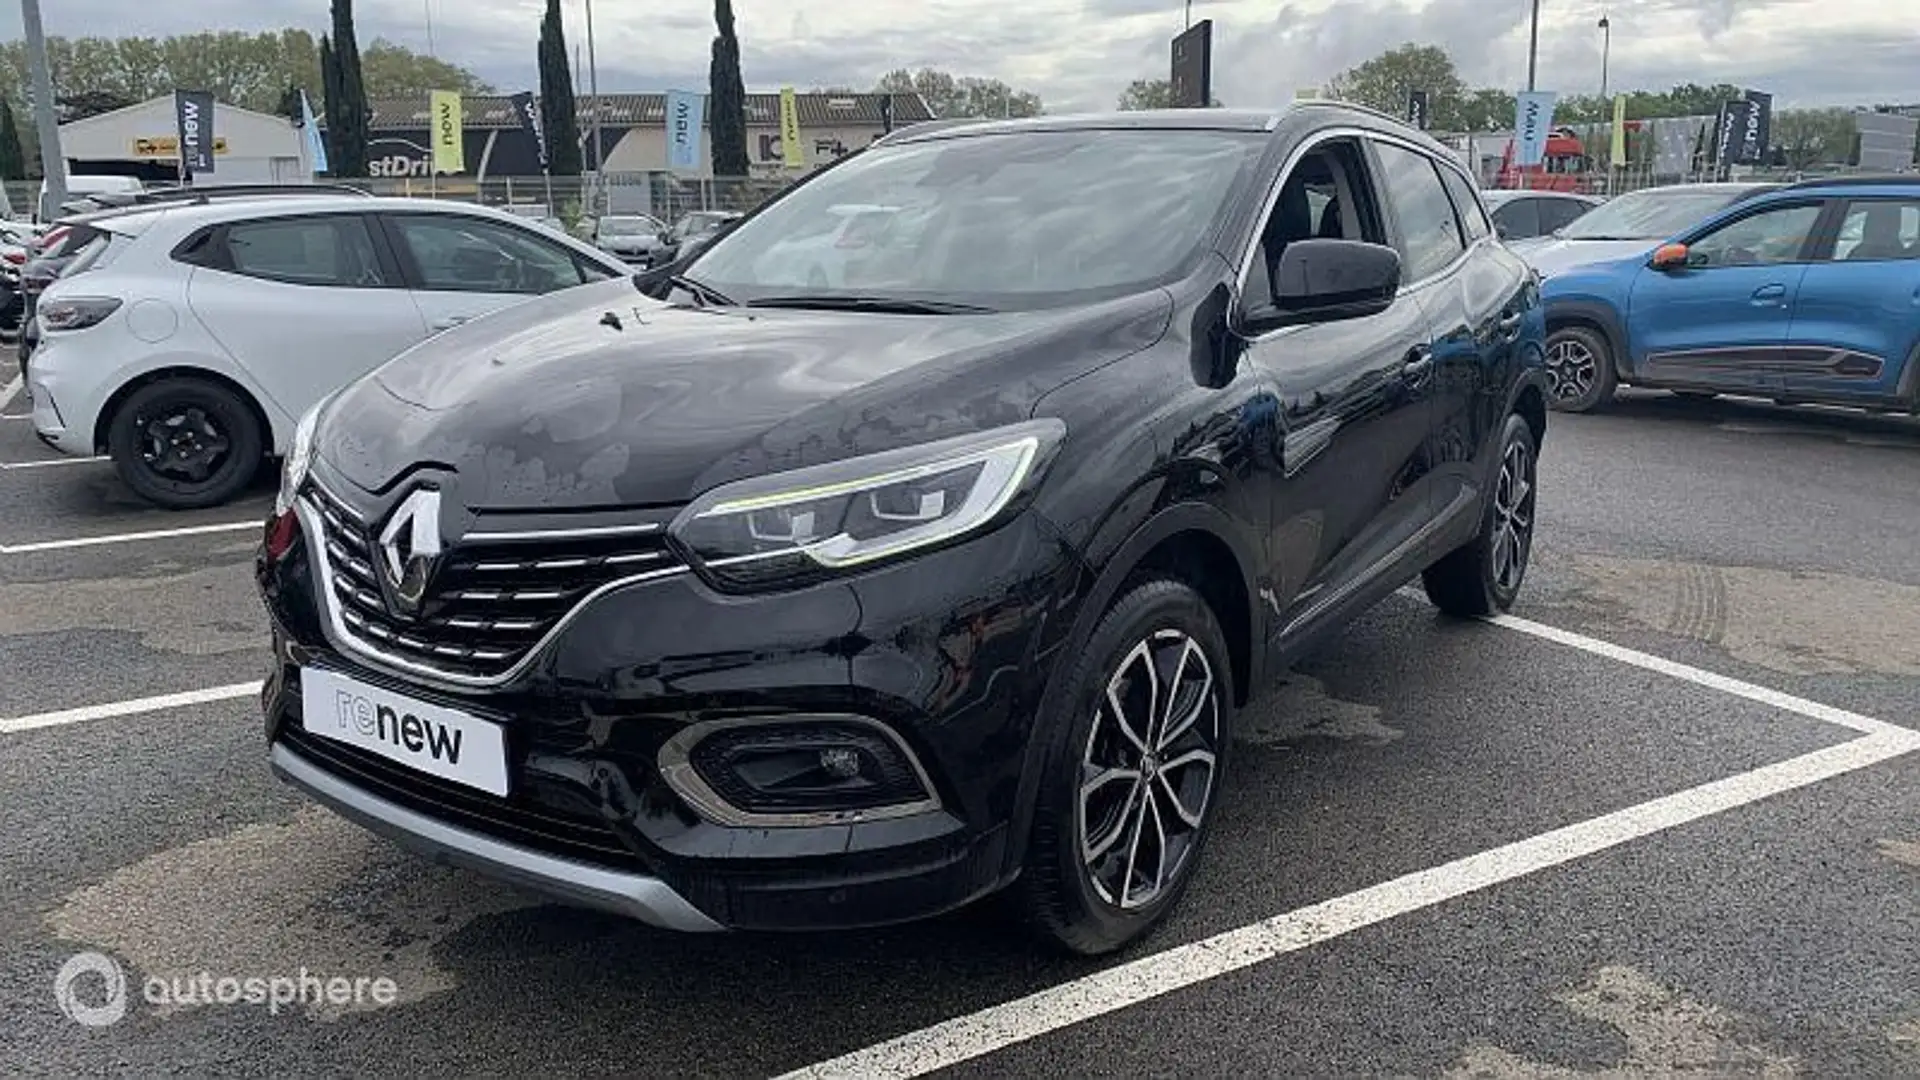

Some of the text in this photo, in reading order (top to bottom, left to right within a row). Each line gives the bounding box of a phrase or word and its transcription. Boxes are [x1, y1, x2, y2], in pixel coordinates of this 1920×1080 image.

[441, 102, 454, 146] new
[676, 101, 690, 145] new
[1523, 101, 1540, 141] new
[336, 688, 463, 766] renew
